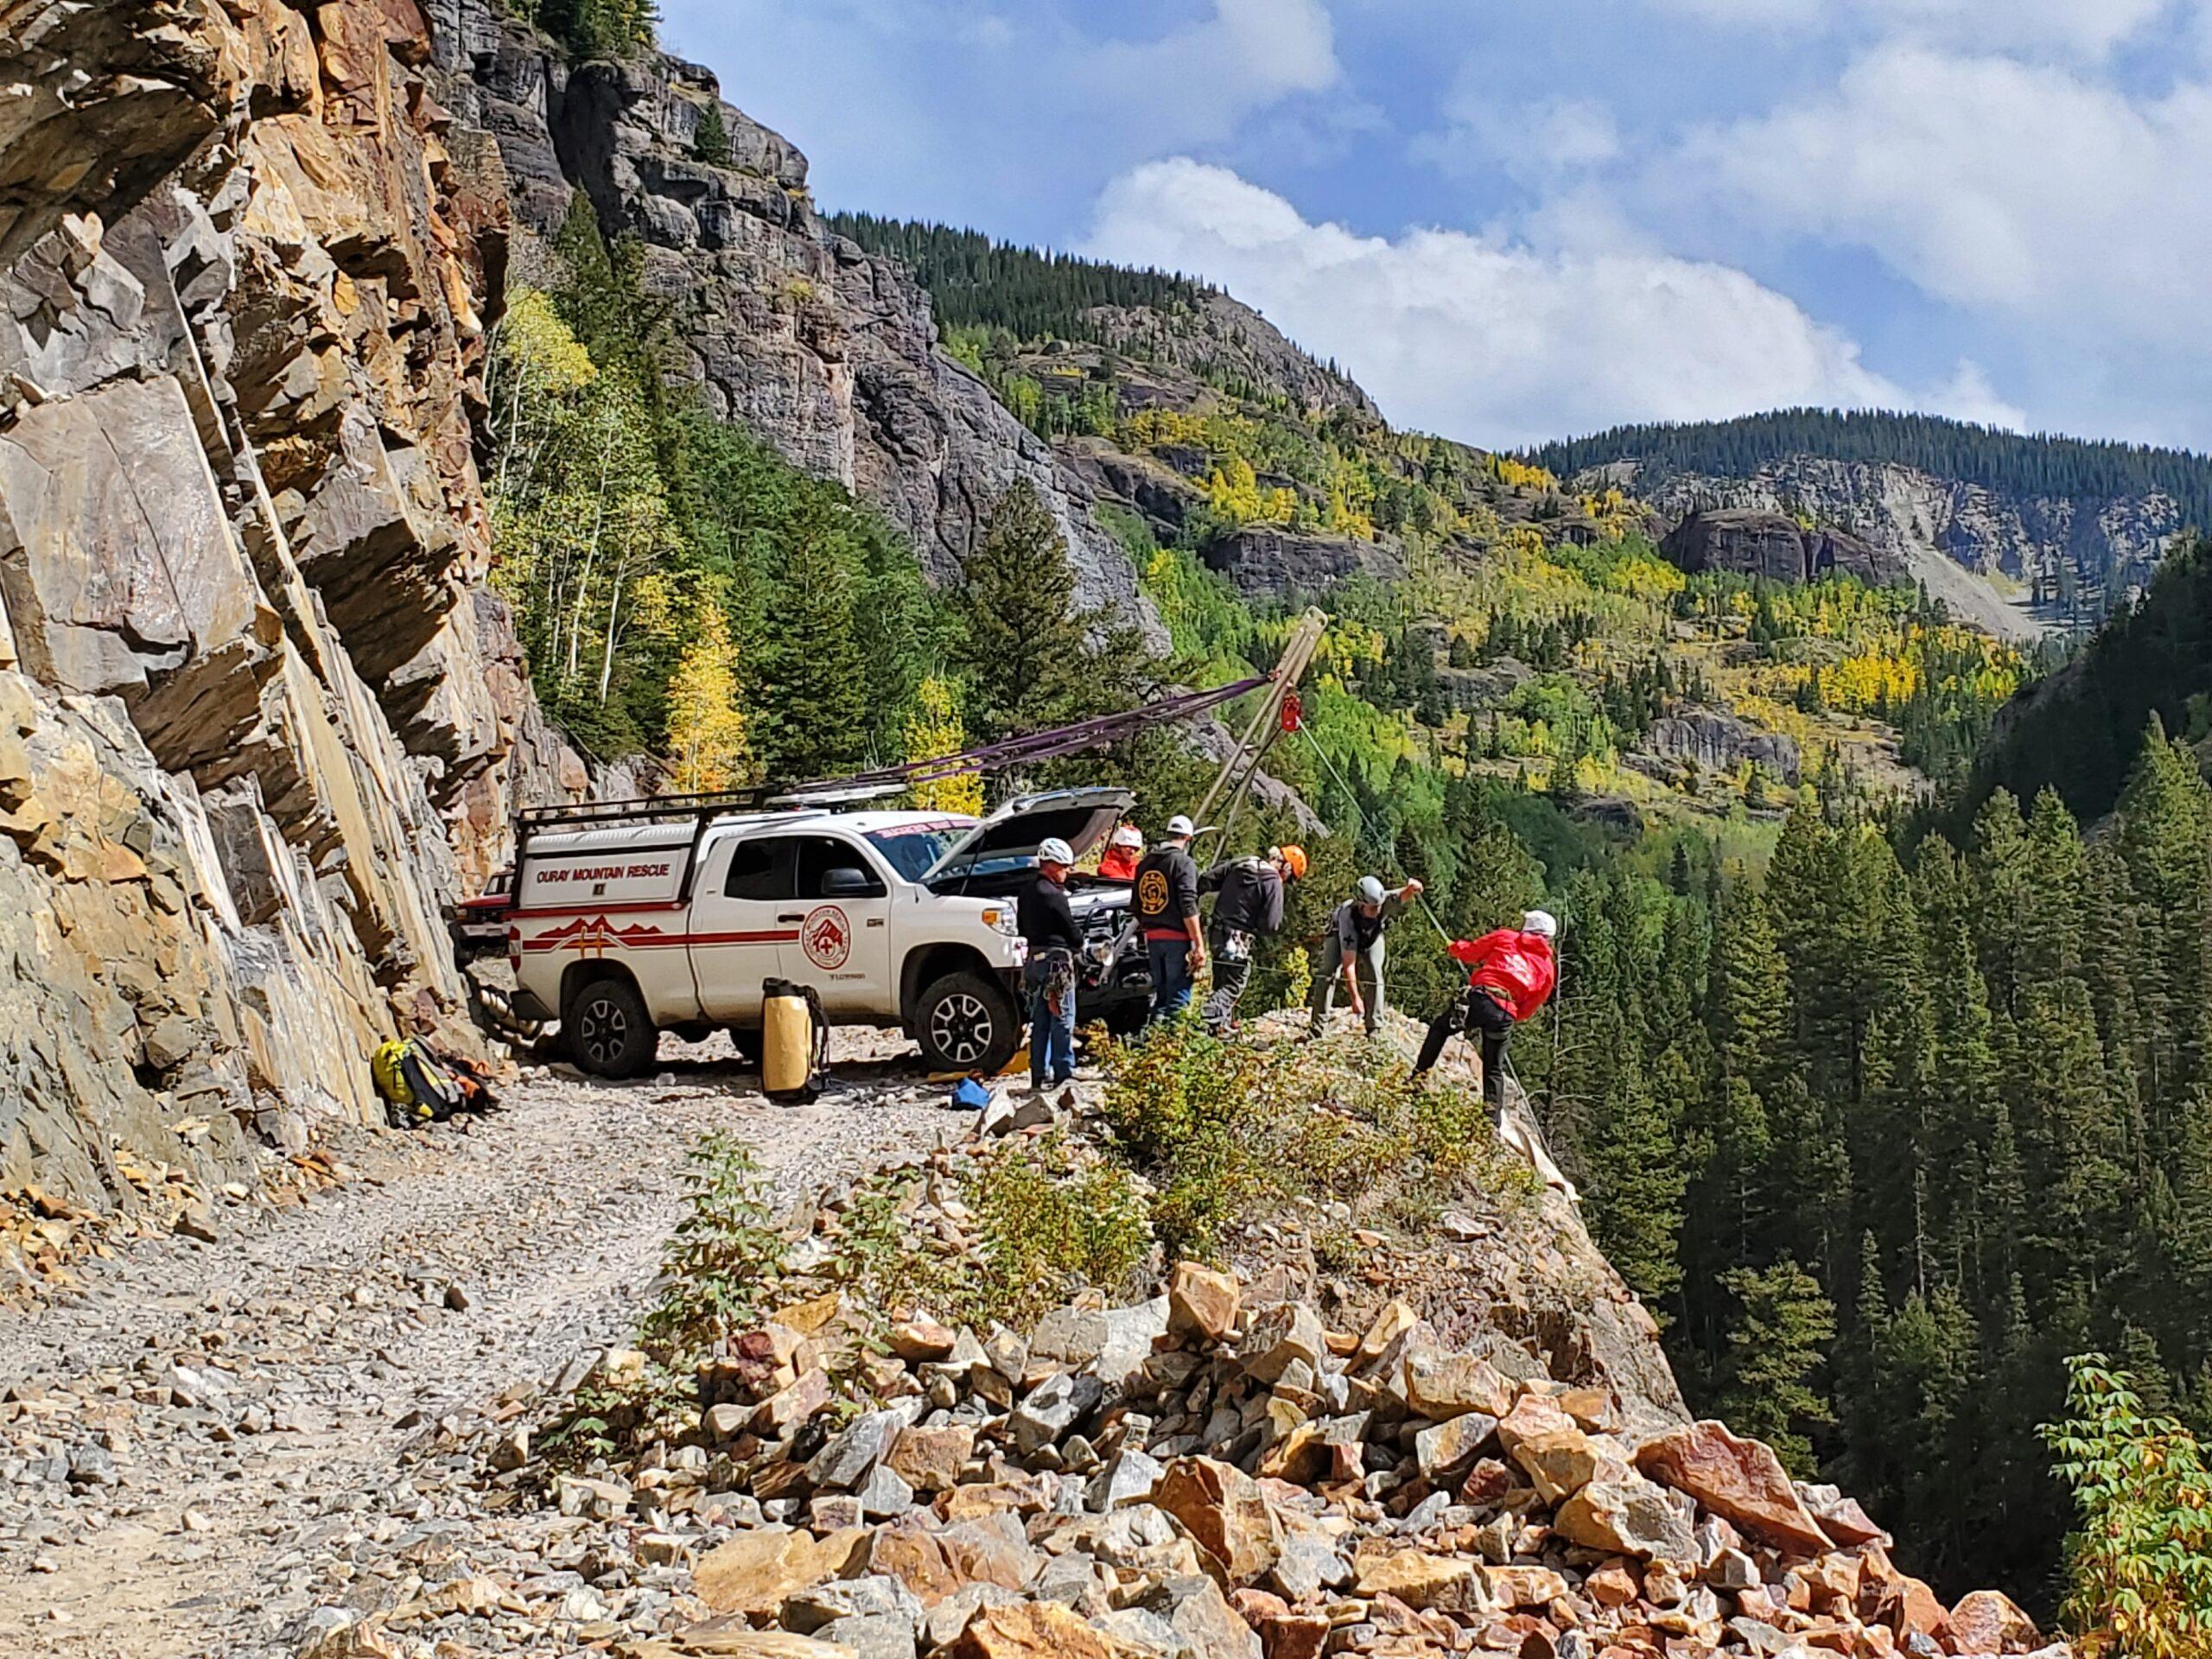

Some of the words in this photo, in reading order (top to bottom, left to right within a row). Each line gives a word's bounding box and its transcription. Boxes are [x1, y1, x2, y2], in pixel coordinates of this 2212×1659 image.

[537, 868, 571, 883] OURAY
[572, 866, 625, 881] MOUNTAIN
[626, 863, 671, 878] RESCUE
